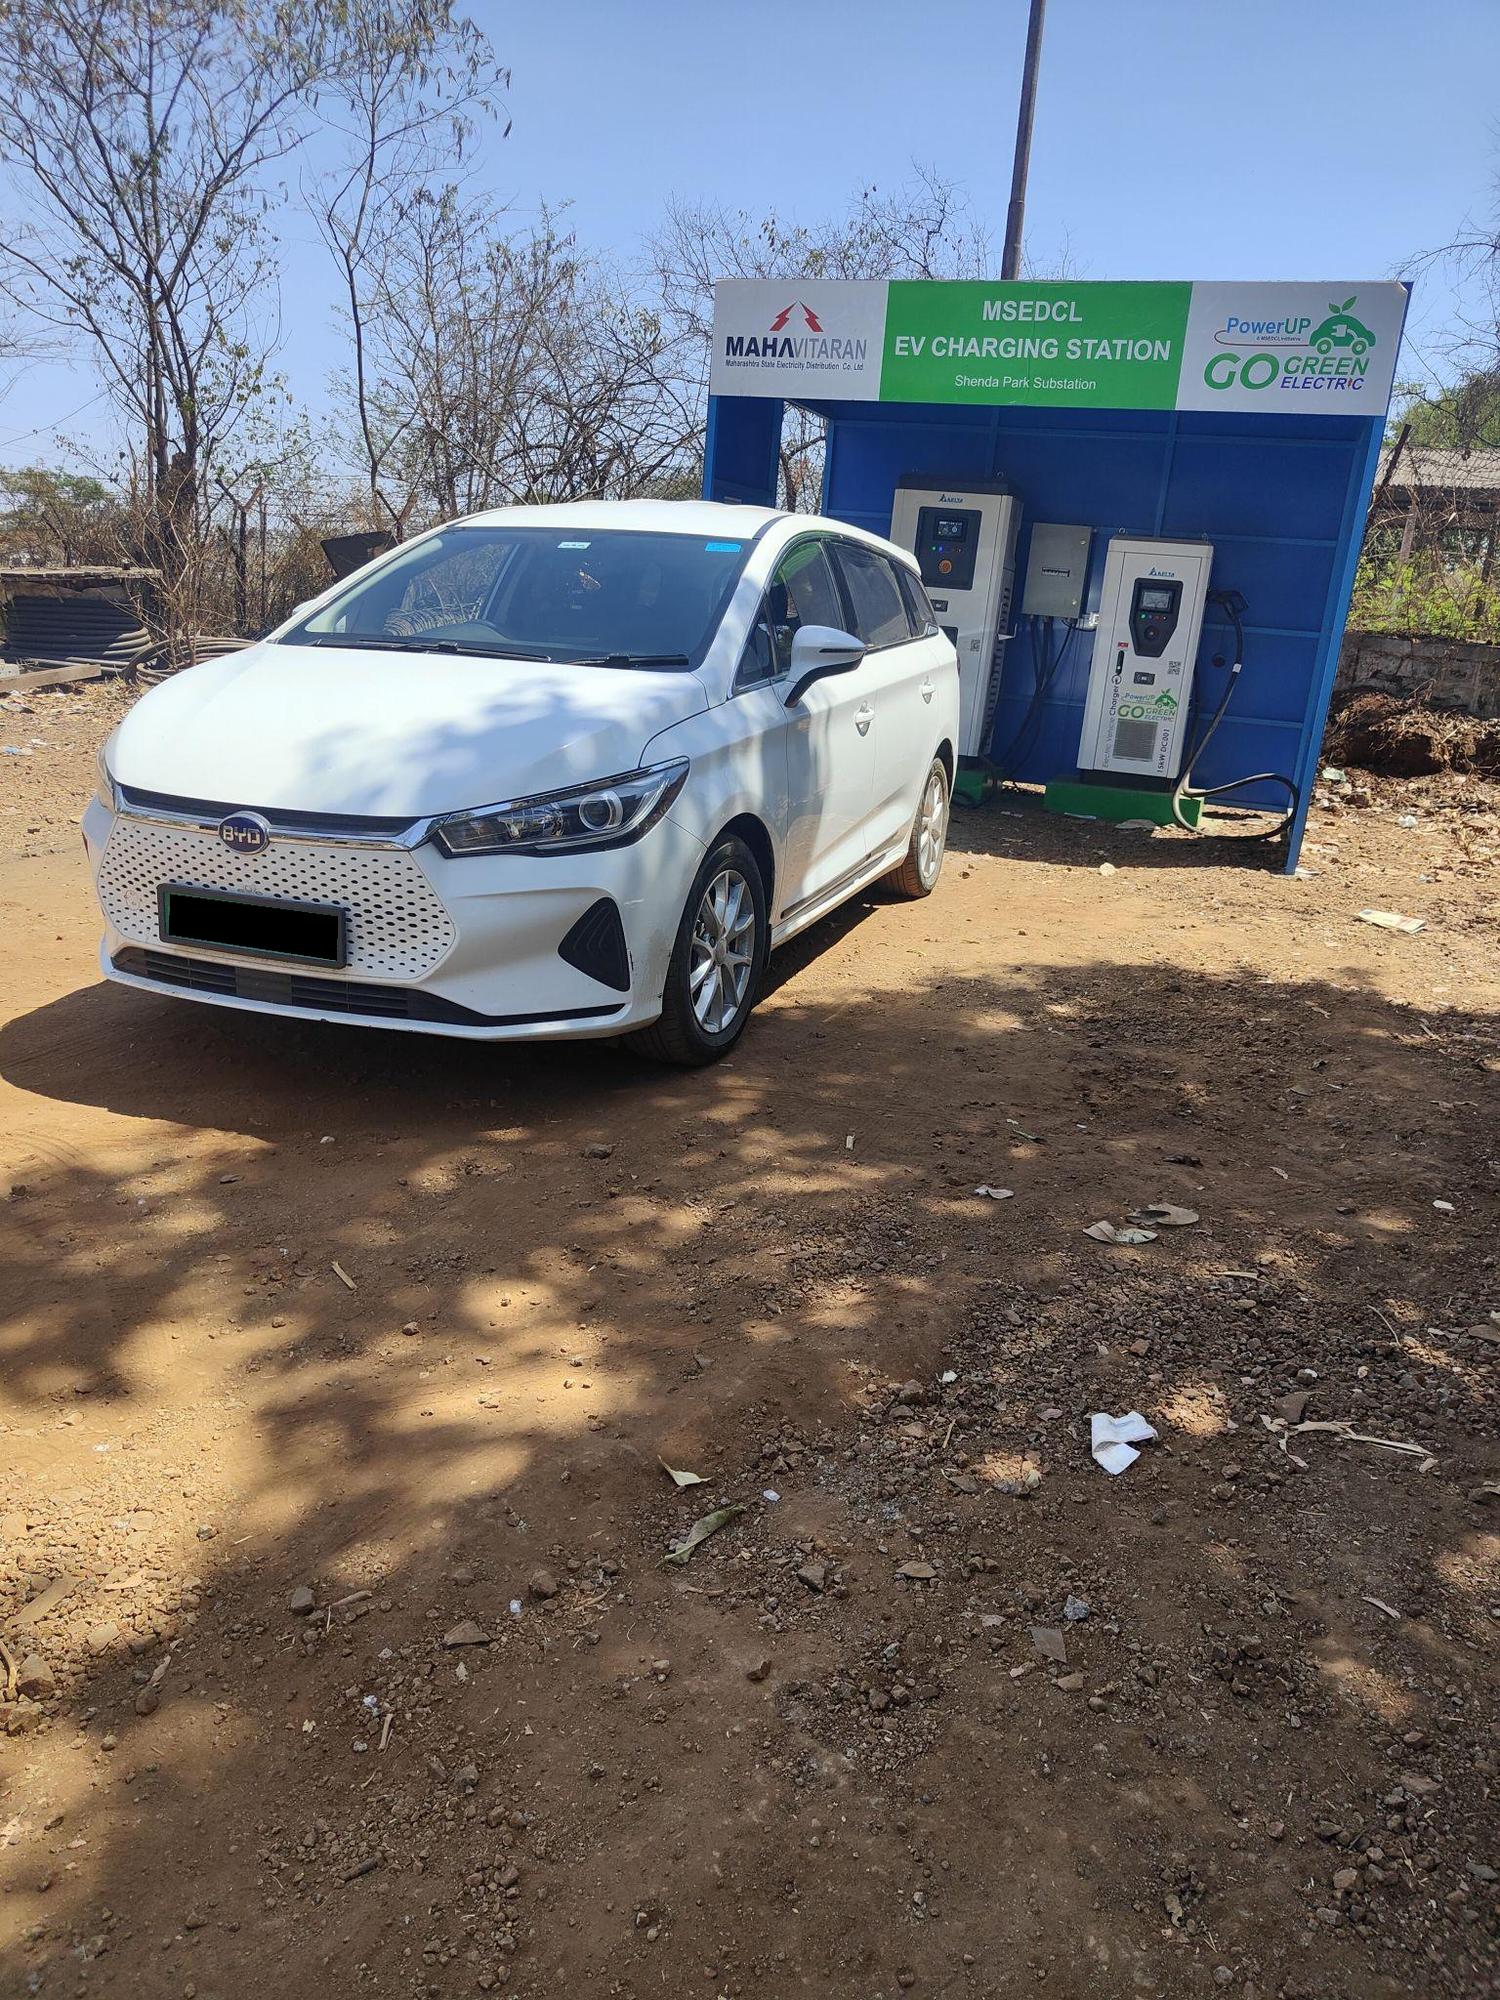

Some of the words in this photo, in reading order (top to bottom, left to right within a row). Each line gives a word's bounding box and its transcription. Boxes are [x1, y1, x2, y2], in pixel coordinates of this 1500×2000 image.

[982, 300, 1083, 322] MSEDCL
[1226, 317, 1311, 334] PowerUP
[725, 336, 867, 360] MAHAVITARAN
[894, 335, 926, 356] EV
[931, 336, 1059, 360] CHARGING
[1065, 338, 1172, 361] STATION
[725, 359, 760, 368] Maharashtra
[776, 360, 805, 371] Electricity
[806, 361, 840, 370] Distribution
[1203, 352, 1280, 390] GO
[1283, 356, 1370, 376] GREEN
[955, 374, 999, 388] Shenda
[1002, 376, 1029, 388] Park
[1033, 377, 1097, 390] Substation
[1280, 376, 1365, 390] ELECTRIC
[1109, 685, 1119, 716] Charger
[1117, 704, 1145, 719] GO
[1146, 707, 1176, 717] GREEN
[223, 825, 261, 844] BYD
